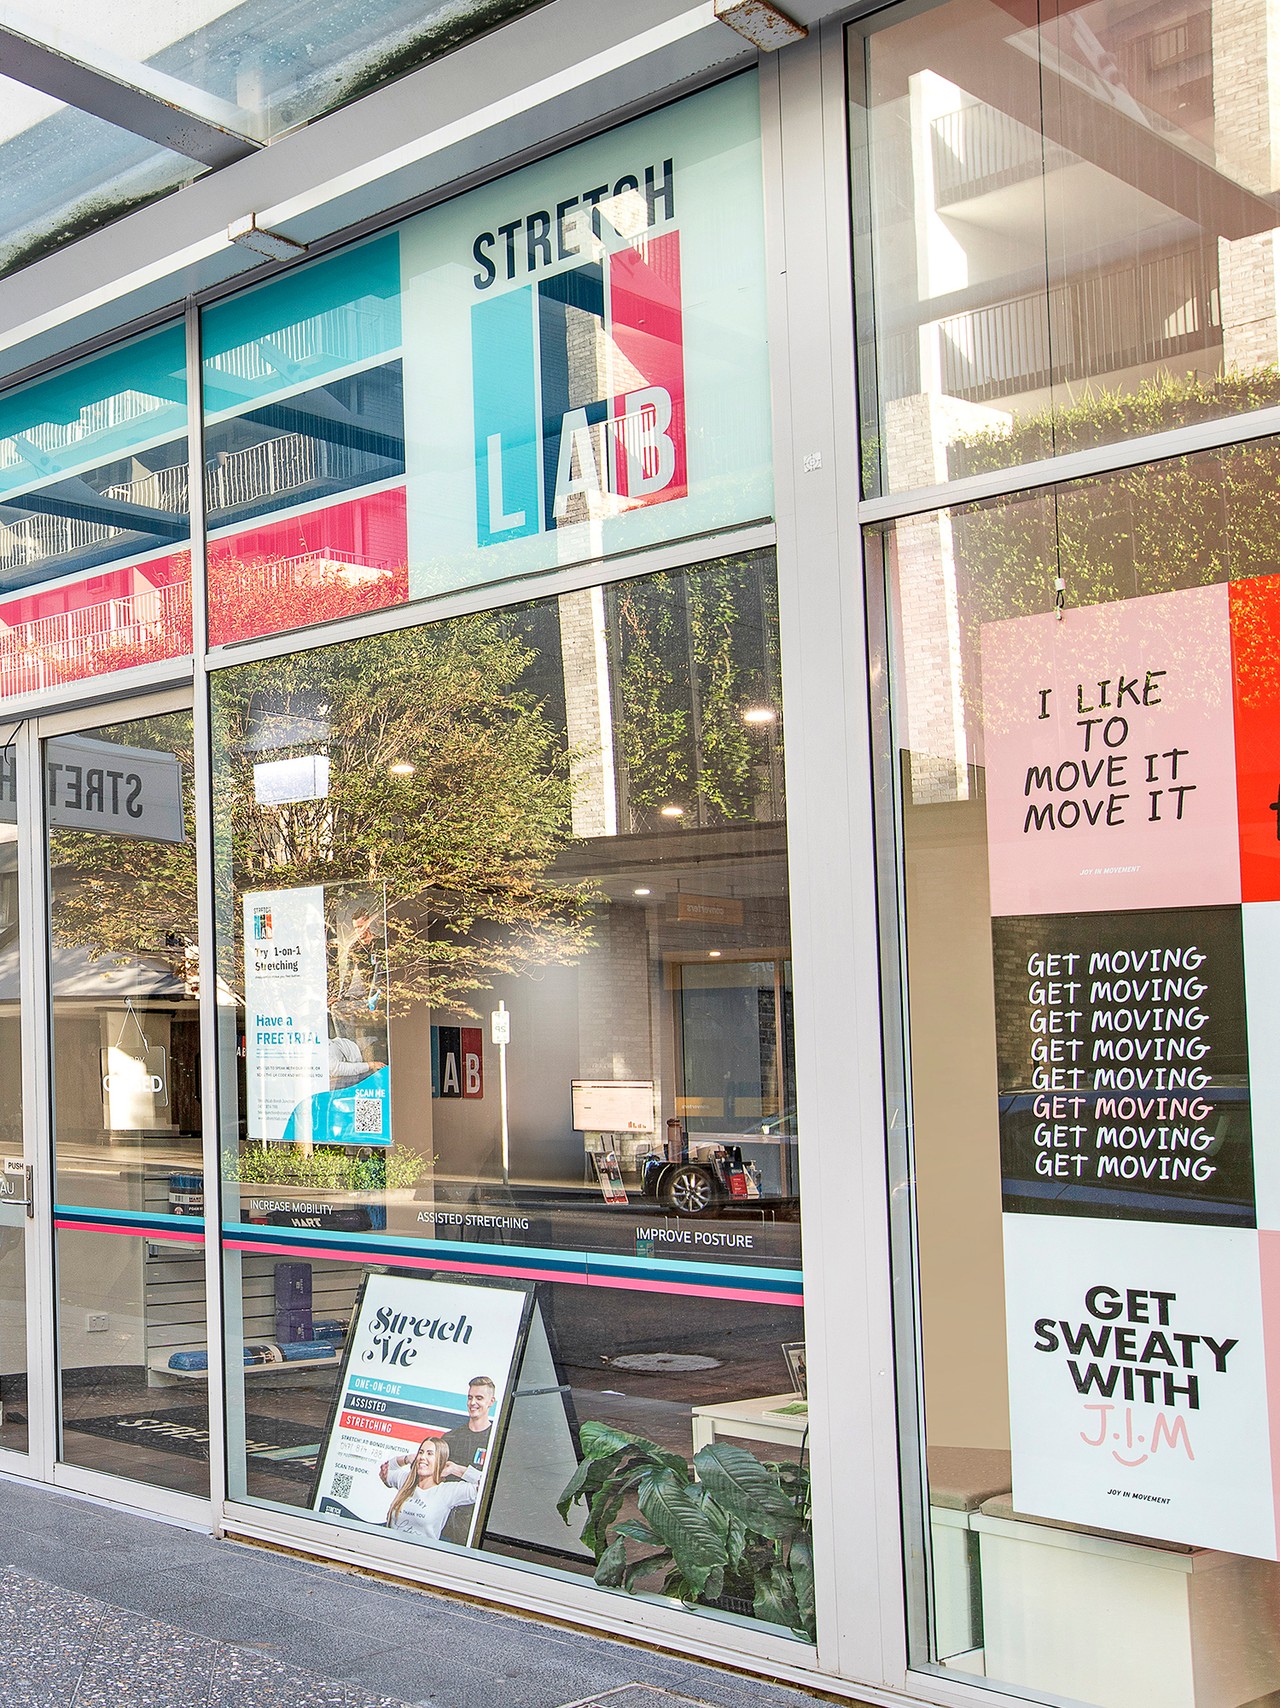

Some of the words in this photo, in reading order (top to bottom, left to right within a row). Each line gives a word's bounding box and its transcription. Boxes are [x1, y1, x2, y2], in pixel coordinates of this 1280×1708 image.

[487, 386, 676, 534] LAB
[1038, 689, 1052, 719] I
[1077, 671, 1166, 714] LIKE
[1077, 716, 1129, 752] TO
[1025, 755, 1127, 796] MOVE
[1145, 748, 1189, 782] IT
[1024, 794, 1129, 833] MOVE
[1148, 785, 1196, 822] IT
[1080, 868, 1093, 876] JOY
[1103, 866, 1141, 874] MOVEMENT
[255, 947, 269, 959] Try
[274, 945, 301, 957] 1-on-1
[1027, 952, 1081, 977] GET
[1089, 946, 1207, 975] MOVING
[255, 960, 299, 973] Stretching
[1028, 980, 1082, 1006] GET
[1090, 976, 1208, 1004] MOVING
[256, 1014, 284, 1027] Have
[286, 1016, 293, 1027] a
[1030, 1009, 1083, 1034] GET
[1091, 1006, 1209, 1033] MOVING
[256, 1032, 285, 1045] FREE
[1031, 1037, 1084, 1063] GET
[1092, 1036, 1211, 1061] MOVING
[431, 1052, 481, 1094] AB
[1032, 1066, 1085, 1090] GET
[1094, 1067, 1212, 1090] MOVING
[355, 1088, 374, 1098] SCAN
[375, 1088, 386, 1098] ME
[1033, 1094, 1086, 1120] GET
[1095, 1097, 1214, 1121] MOVING
[1034, 1123, 1088, 1148] GET
[1096, 1126, 1215, 1151] MOVING
[8, 1161, 24, 1170] PUSH
[1035, 1151, 1088, 1177] GET
[1097, 1155, 1217, 1181] MOVING
[250, 1200, 291, 1213] INCREASE
[292, 1202, 333, 1215] MOBILITY
[417, 1211, 463, 1225] ASSISTED
[465, 1213, 529, 1230] STRETCHING
[636, 1227, 692, 1244] IMPROVE
[694, 1231, 753, 1248] POSTURE
[1085, 1285, 1176, 1327] GET
[369, 1306, 473, 1345] Stretch
[361, 1336, 417, 1367] Me
[1034, 1318, 1239, 1373] SWEATY
[354, 1378, 402, 1396] ONE-ON-ONE
[1066, 1359, 1199, 1410] WITH
[350, 1397, 387, 1412] ASSISTED
[345, 1415, 392, 1433] STRETCHING
[369, 1440, 385, 1448] BONDI
[385, 1443, 409, 1453] JUNCTION
[335, 1462, 347, 1470] SCAN
[1132, 1492, 1171, 1505] MOVEMENT
